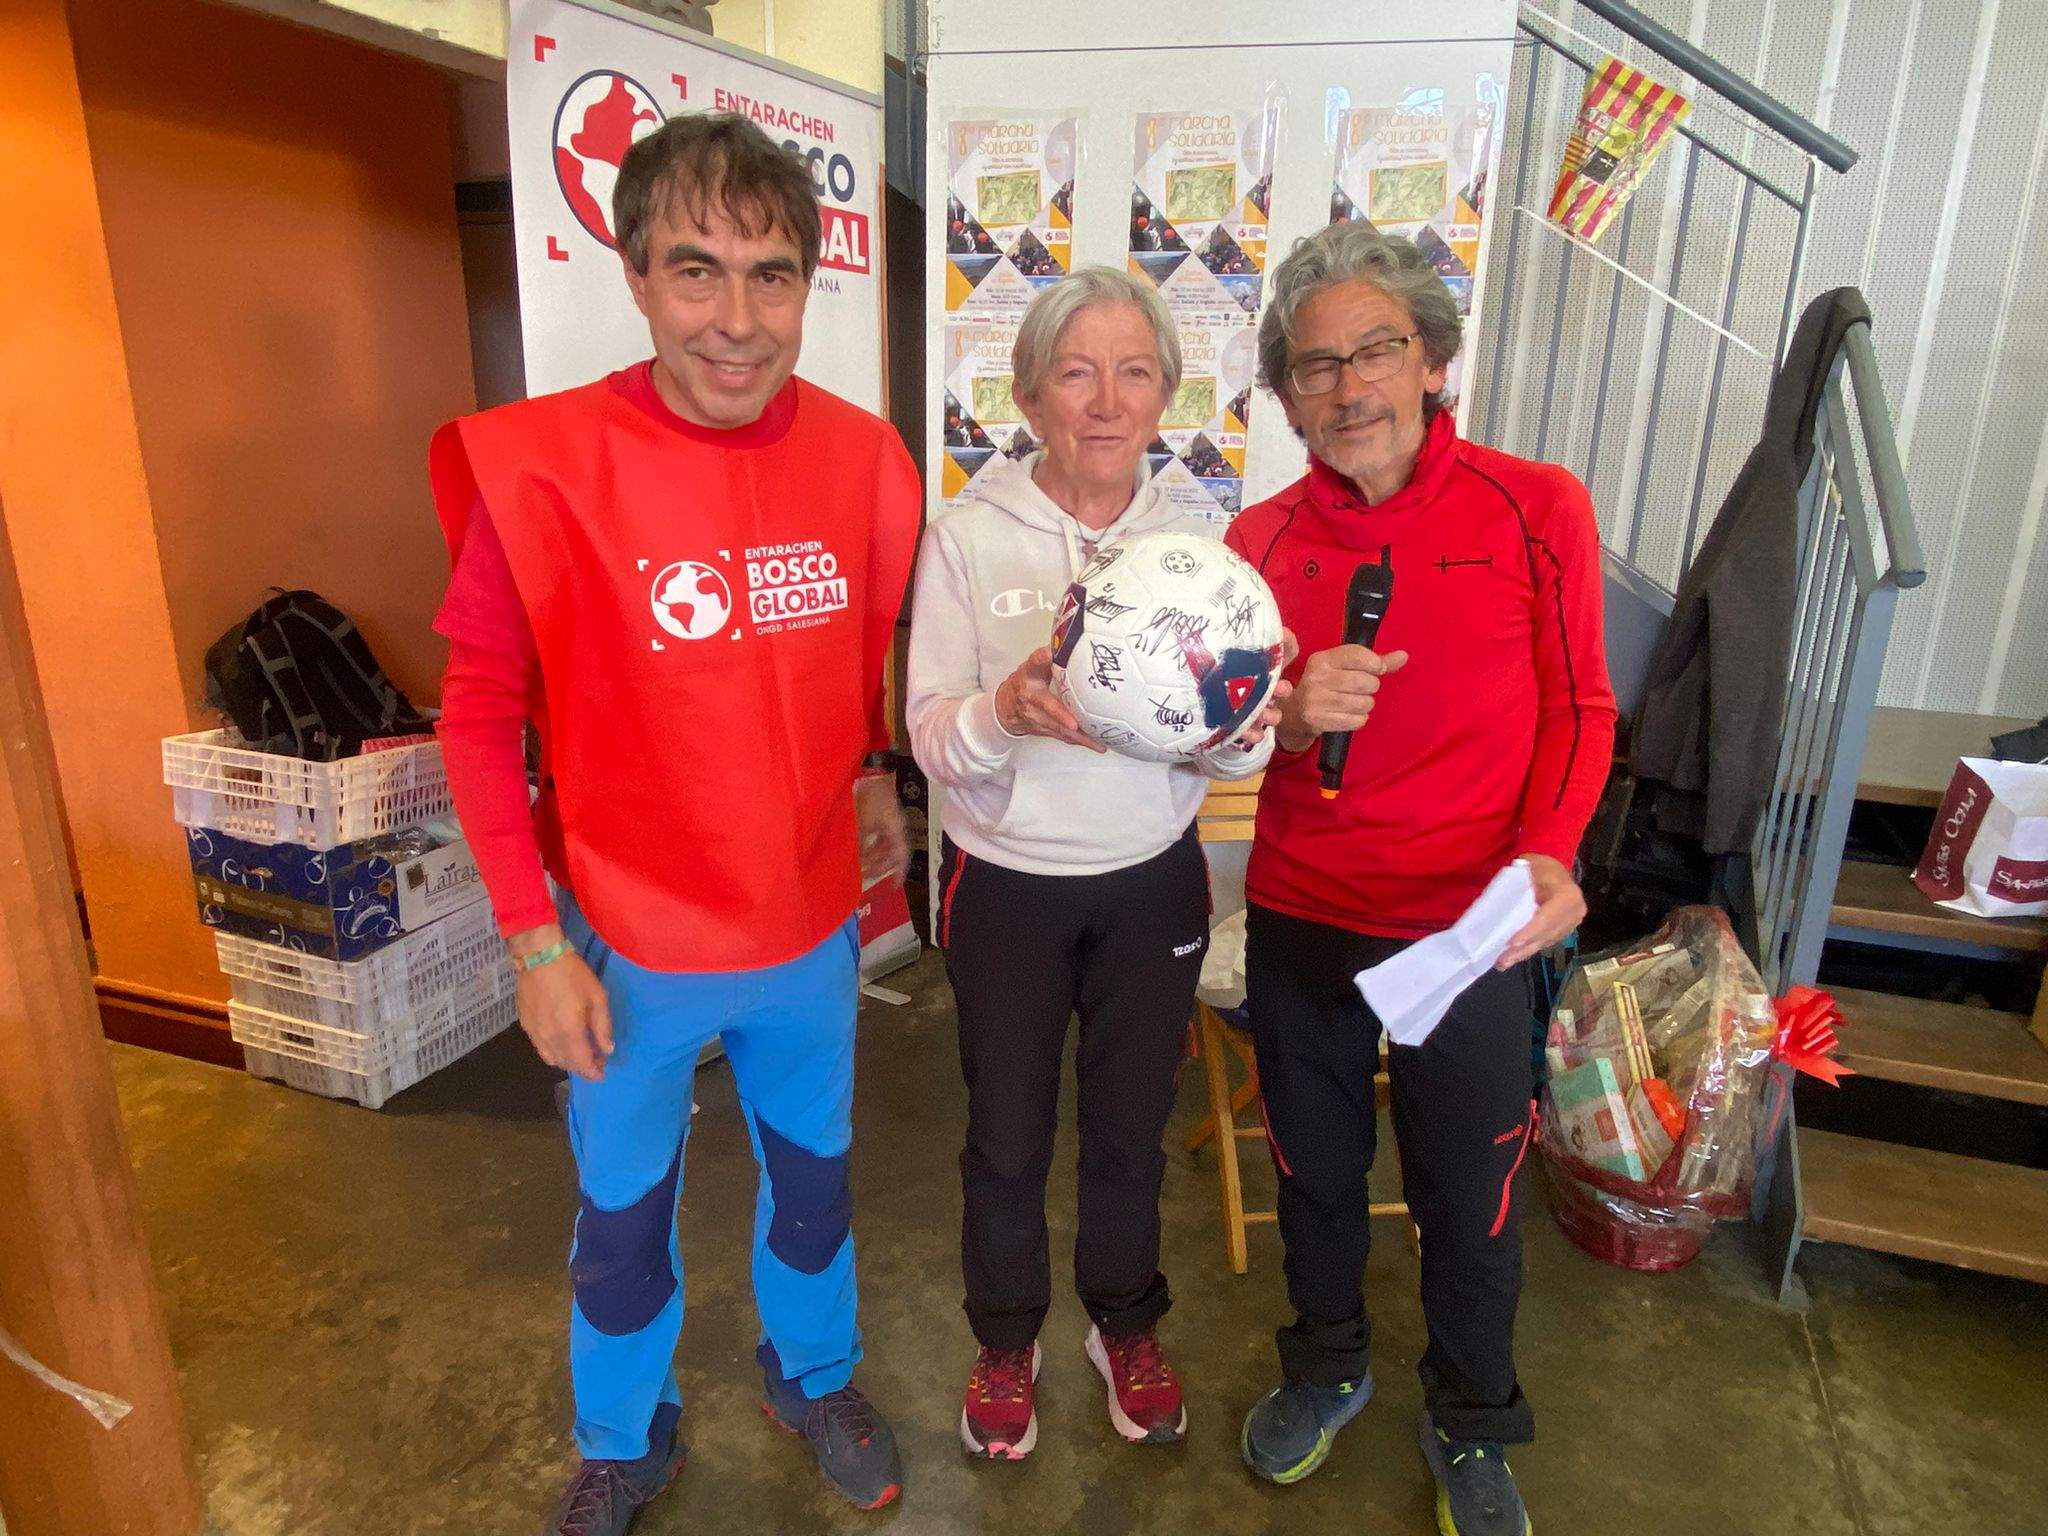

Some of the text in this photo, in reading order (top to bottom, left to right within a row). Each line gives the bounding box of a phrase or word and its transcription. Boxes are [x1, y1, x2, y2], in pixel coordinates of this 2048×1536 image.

[714, 88, 834, 143] ENTARACHEN
[811, 273, 841, 294] IANA
[745, 540, 823, 560] ENTARACHEN
[746, 552, 838, 589] BOSCO
[753, 583, 845, 618] GLOBAL
[756, 623, 783, 636] ONGD
[786, 616, 831, 631] SALESIANA
